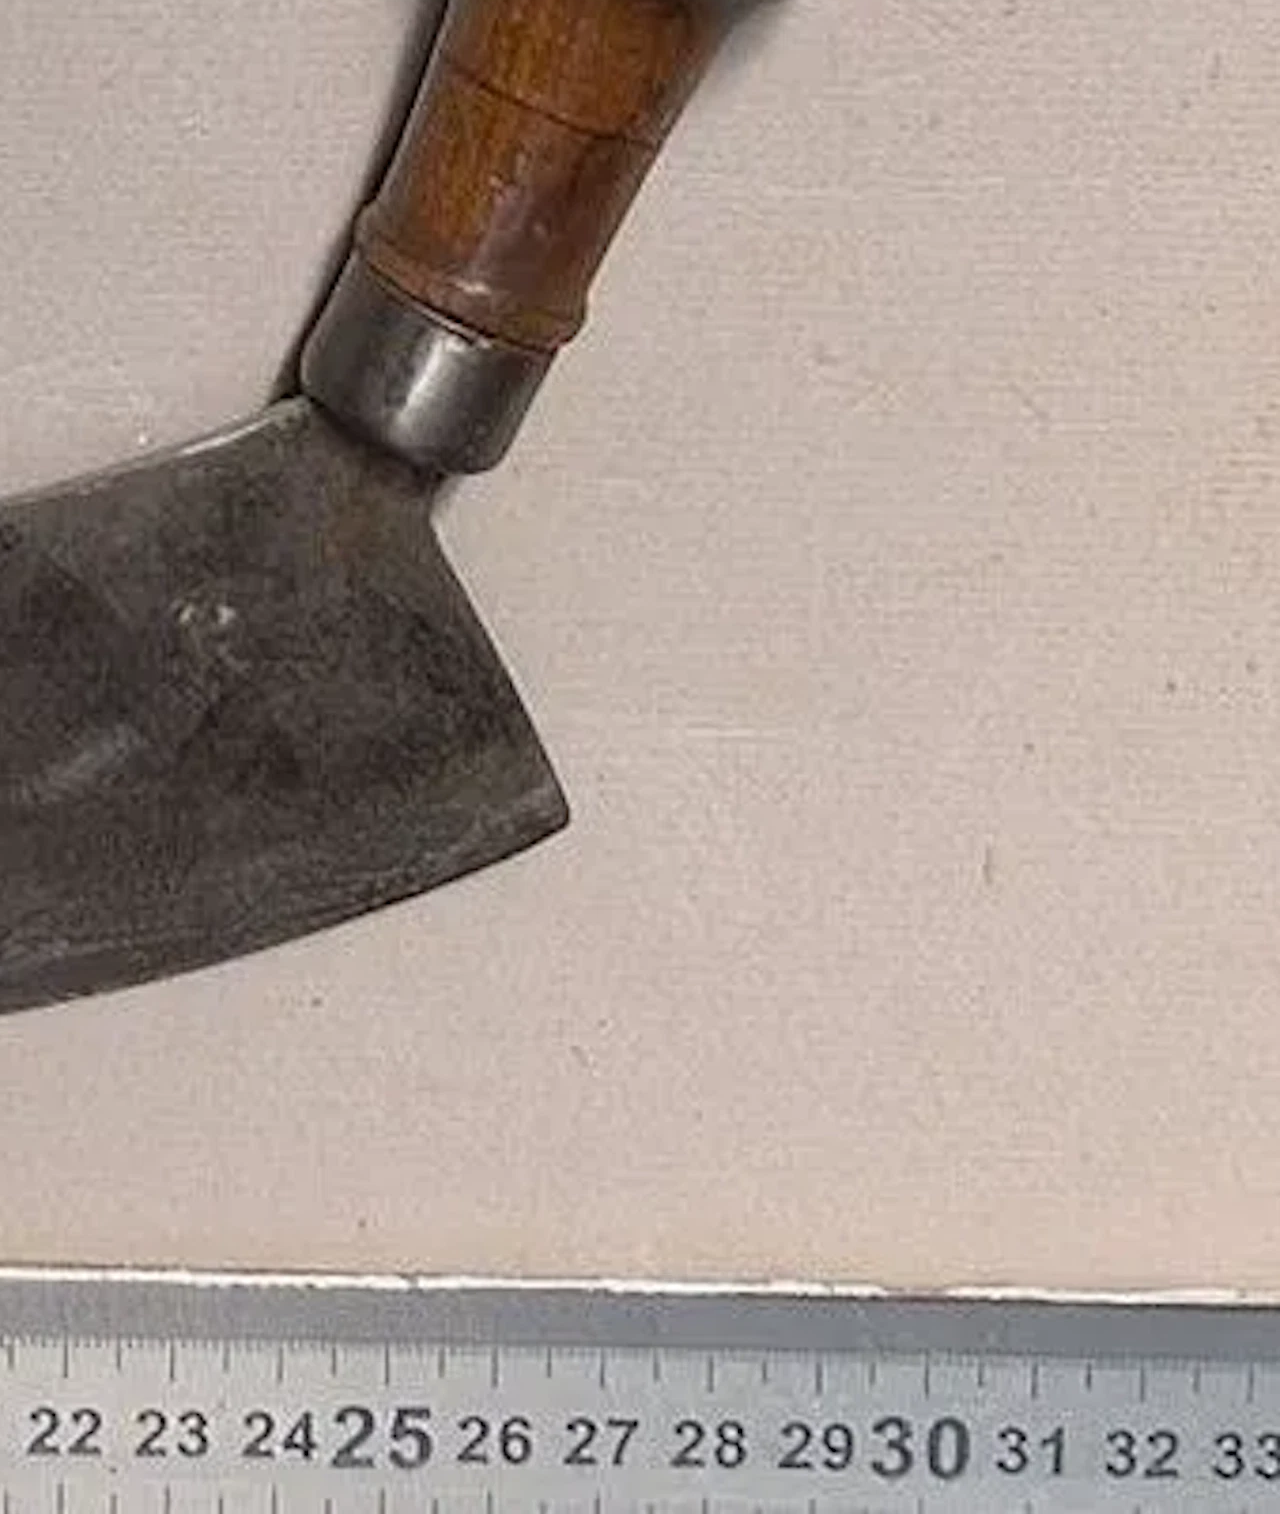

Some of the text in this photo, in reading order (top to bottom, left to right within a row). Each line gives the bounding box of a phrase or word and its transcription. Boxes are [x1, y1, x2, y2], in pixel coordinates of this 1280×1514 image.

[25, 1406, 103, 1458] 22
[133, 1408, 210, 1459] 23
[240, 1410, 319, 1462] 24
[330, 1404, 434, 1472] 25
[456, 1415, 533, 1466] 26
[562, 1416, 640, 1467] 27
[669, 1419, 748, 1470] 28
[777, 1421, 855, 1473] 29
[870, 1415, 971, 1482] 30
[995, 1425, 1065, 1477] 31
[1105, 1428, 1180, 1480] 32
[1211, 1431, 1280, 1482] 33
